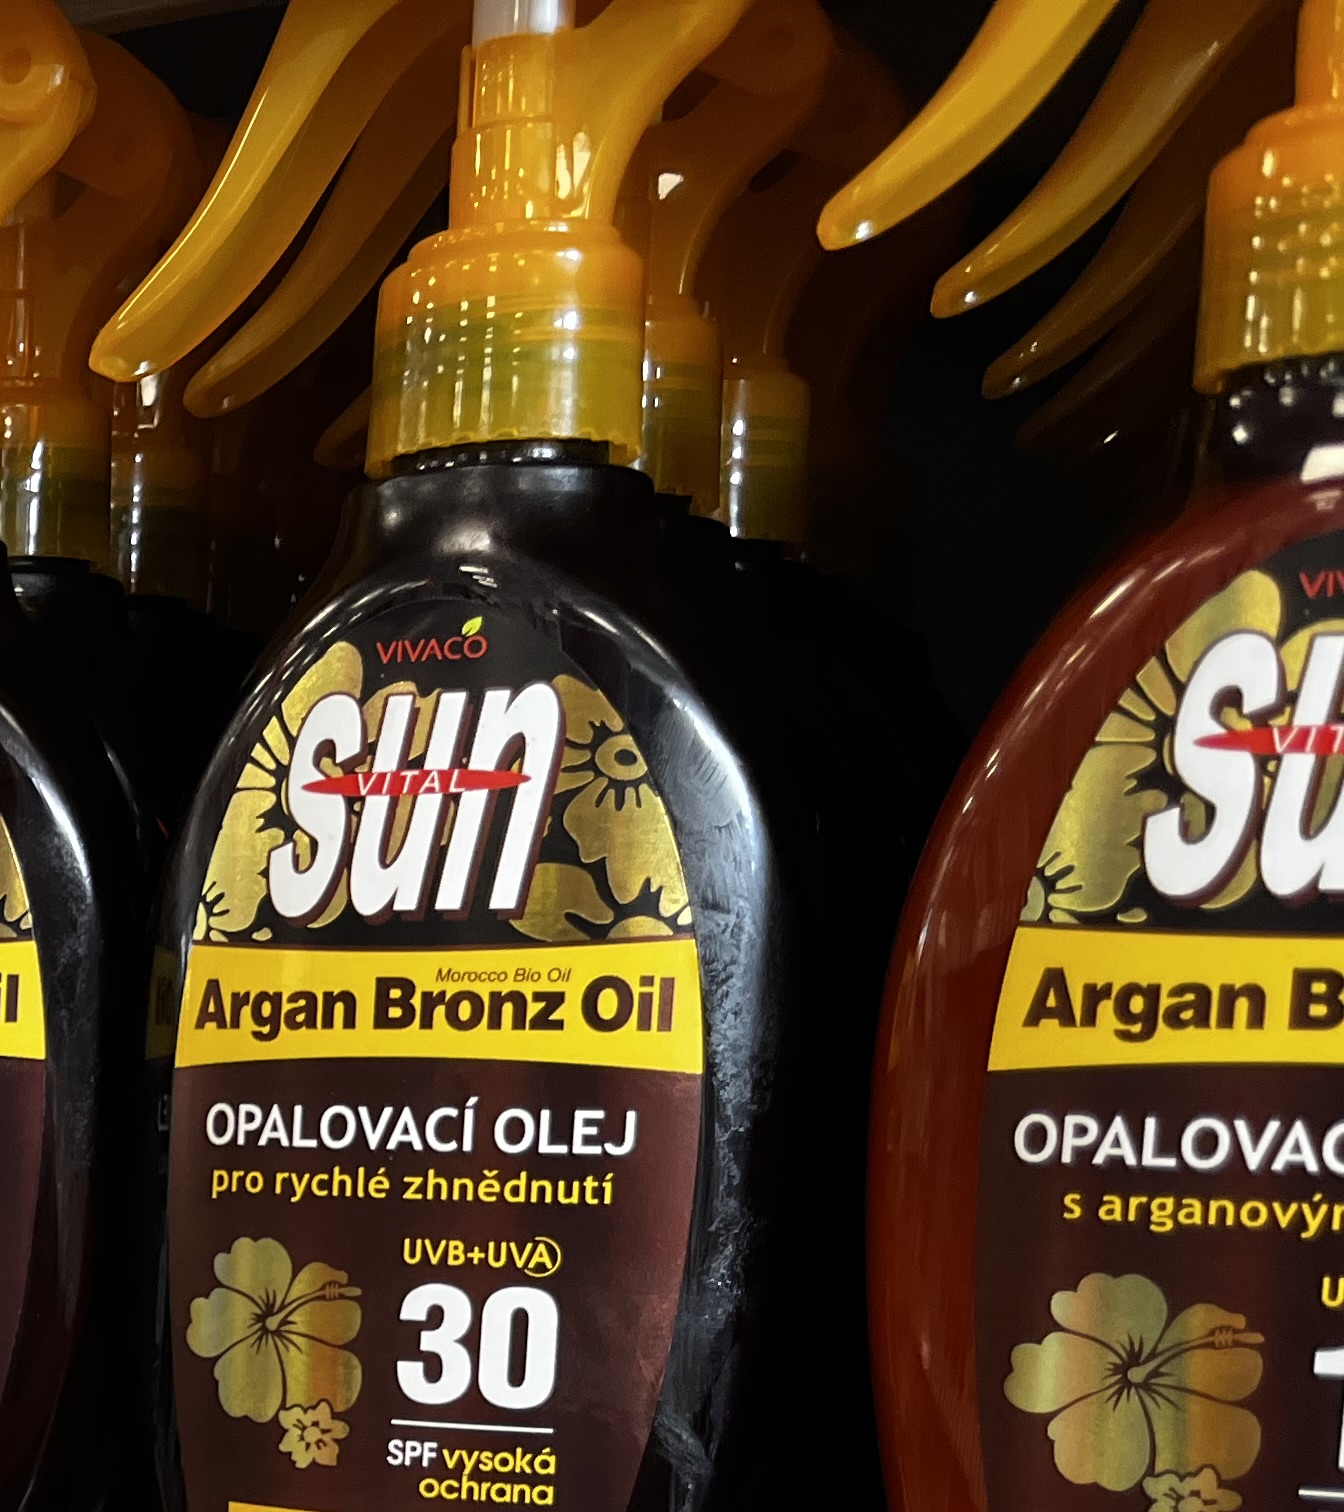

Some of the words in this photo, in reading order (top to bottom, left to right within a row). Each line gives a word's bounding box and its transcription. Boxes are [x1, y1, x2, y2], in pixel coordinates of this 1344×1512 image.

[376, 633, 488, 664] VIVACO
[356, 769, 466, 795] VITAL
[267, 682, 566, 925] sun
[435, 969, 508, 984] Morocco
[513, 969, 542, 983] Bio
[548, 968, 572, 983] Oil
[194, 978, 357, 1041] Argan
[373, 977, 565, 1031] Bronz
[580, 975, 674, 1033] Oil
[1022, 967, 1267, 1044] Argan
[205, 1097, 479, 1152] OPALOVACÍ
[493, 1108, 638, 1156] OLEJ
[212, 1168, 265, 1198] pro
[274, 1167, 391, 1202] rychlé
[402, 1169, 615, 1205] zhnědnutí
[402, 1237, 562, 1277] UVB+UVA
[396, 1283, 559, 1409] 30
[386, 1440, 437, 1468] SPF
[443, 1446, 557, 1477] vysoká
[418, 1474, 554, 1506] ochrana
